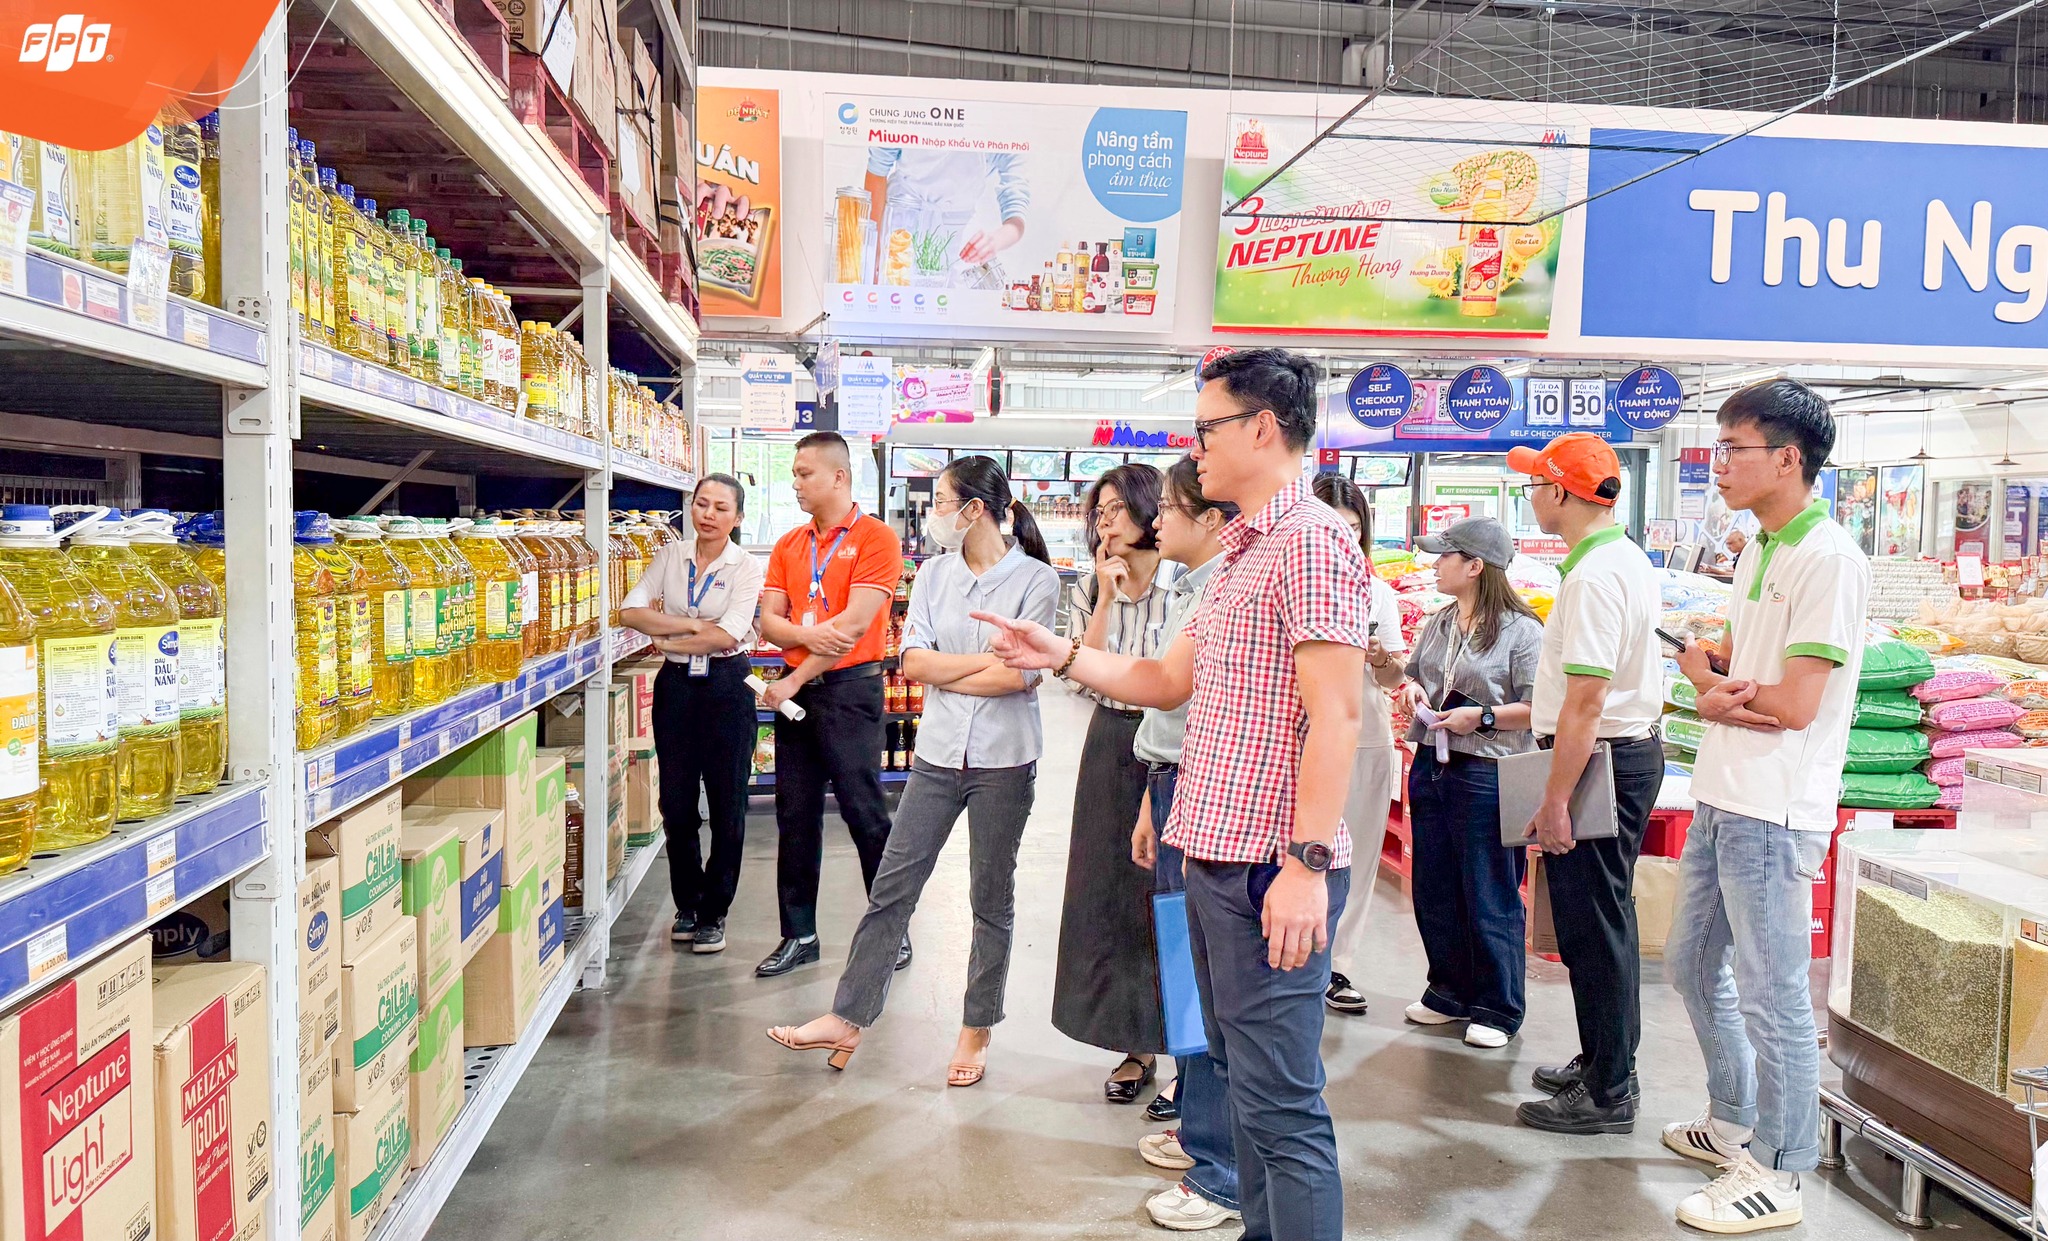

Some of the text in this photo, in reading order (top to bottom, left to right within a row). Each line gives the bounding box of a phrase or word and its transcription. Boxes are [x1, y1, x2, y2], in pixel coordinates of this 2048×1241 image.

[869, 107, 965, 120] CHUNG JUNG ONE
[868, 129, 919, 145] Miwon
[922, 137, 946, 148] Nhập
[948, 137, 970, 148] Khẩu
[973, 139, 985, 148] Và
[1096, 130, 1173, 151] Nâng tầm
[1088, 150, 1172, 171] phong cách
[1235, 149, 1267, 159] Neptune
[175, 166, 200, 185] Simply
[1108, 170, 1173, 190] ẩm thực
[1234, 196, 1264, 236] 3
[1226, 222, 1382, 269] NEPTUNE
[1689, 189, 2048, 323] Thu Ng
[1291, 252, 1403, 288] Thượng Hạng
[1368, 384, 1392, 393] SELF
[1355, 395, 1404, 405] CHECKOUT
[1451, 397, 1510, 408] THANH TOÁN
[1533, 394, 1558, 416] 10
[1572, 394, 1601, 416] 30
[1618, 397, 1680, 408] THANH TOÁN
[1358, 408, 1402, 418] COUNTER
[1458, 409, 1500, 422] TỰ ĐỘNG
[1626, 409, 1671, 422] TỰ ĐỘNG
[1326, 451, 1334, 461] 2
[1700, 450, 1704, 461] 1
[1455, 486, 1493, 495] EMERGENCY
[154, 664, 172, 674] ĐẬU
[154, 674, 177, 687] NÀNH
[11, 716, 30, 730] ĐẬU
[53, 735, 78, 744] wilmar
[368, 881, 388, 899] COOKING
[307, 921, 328, 945] Simply
[41, 951, 67, 973] 1.120.000
[381, 1014, 409, 1044] COOKING OIL
[49, 1049, 60, 1062] NAM
[80, 1044, 91, 1056] DẦU
[183, 1054, 236, 1116] MEIZAN
[47, 1053, 127, 1136] Neptune
[195, 1094, 228, 1157] GOLD
[51, 1113, 105, 1207] Light
[313, 1186, 323, 1203] OIL
[137, 1222, 141, 1232] 5
